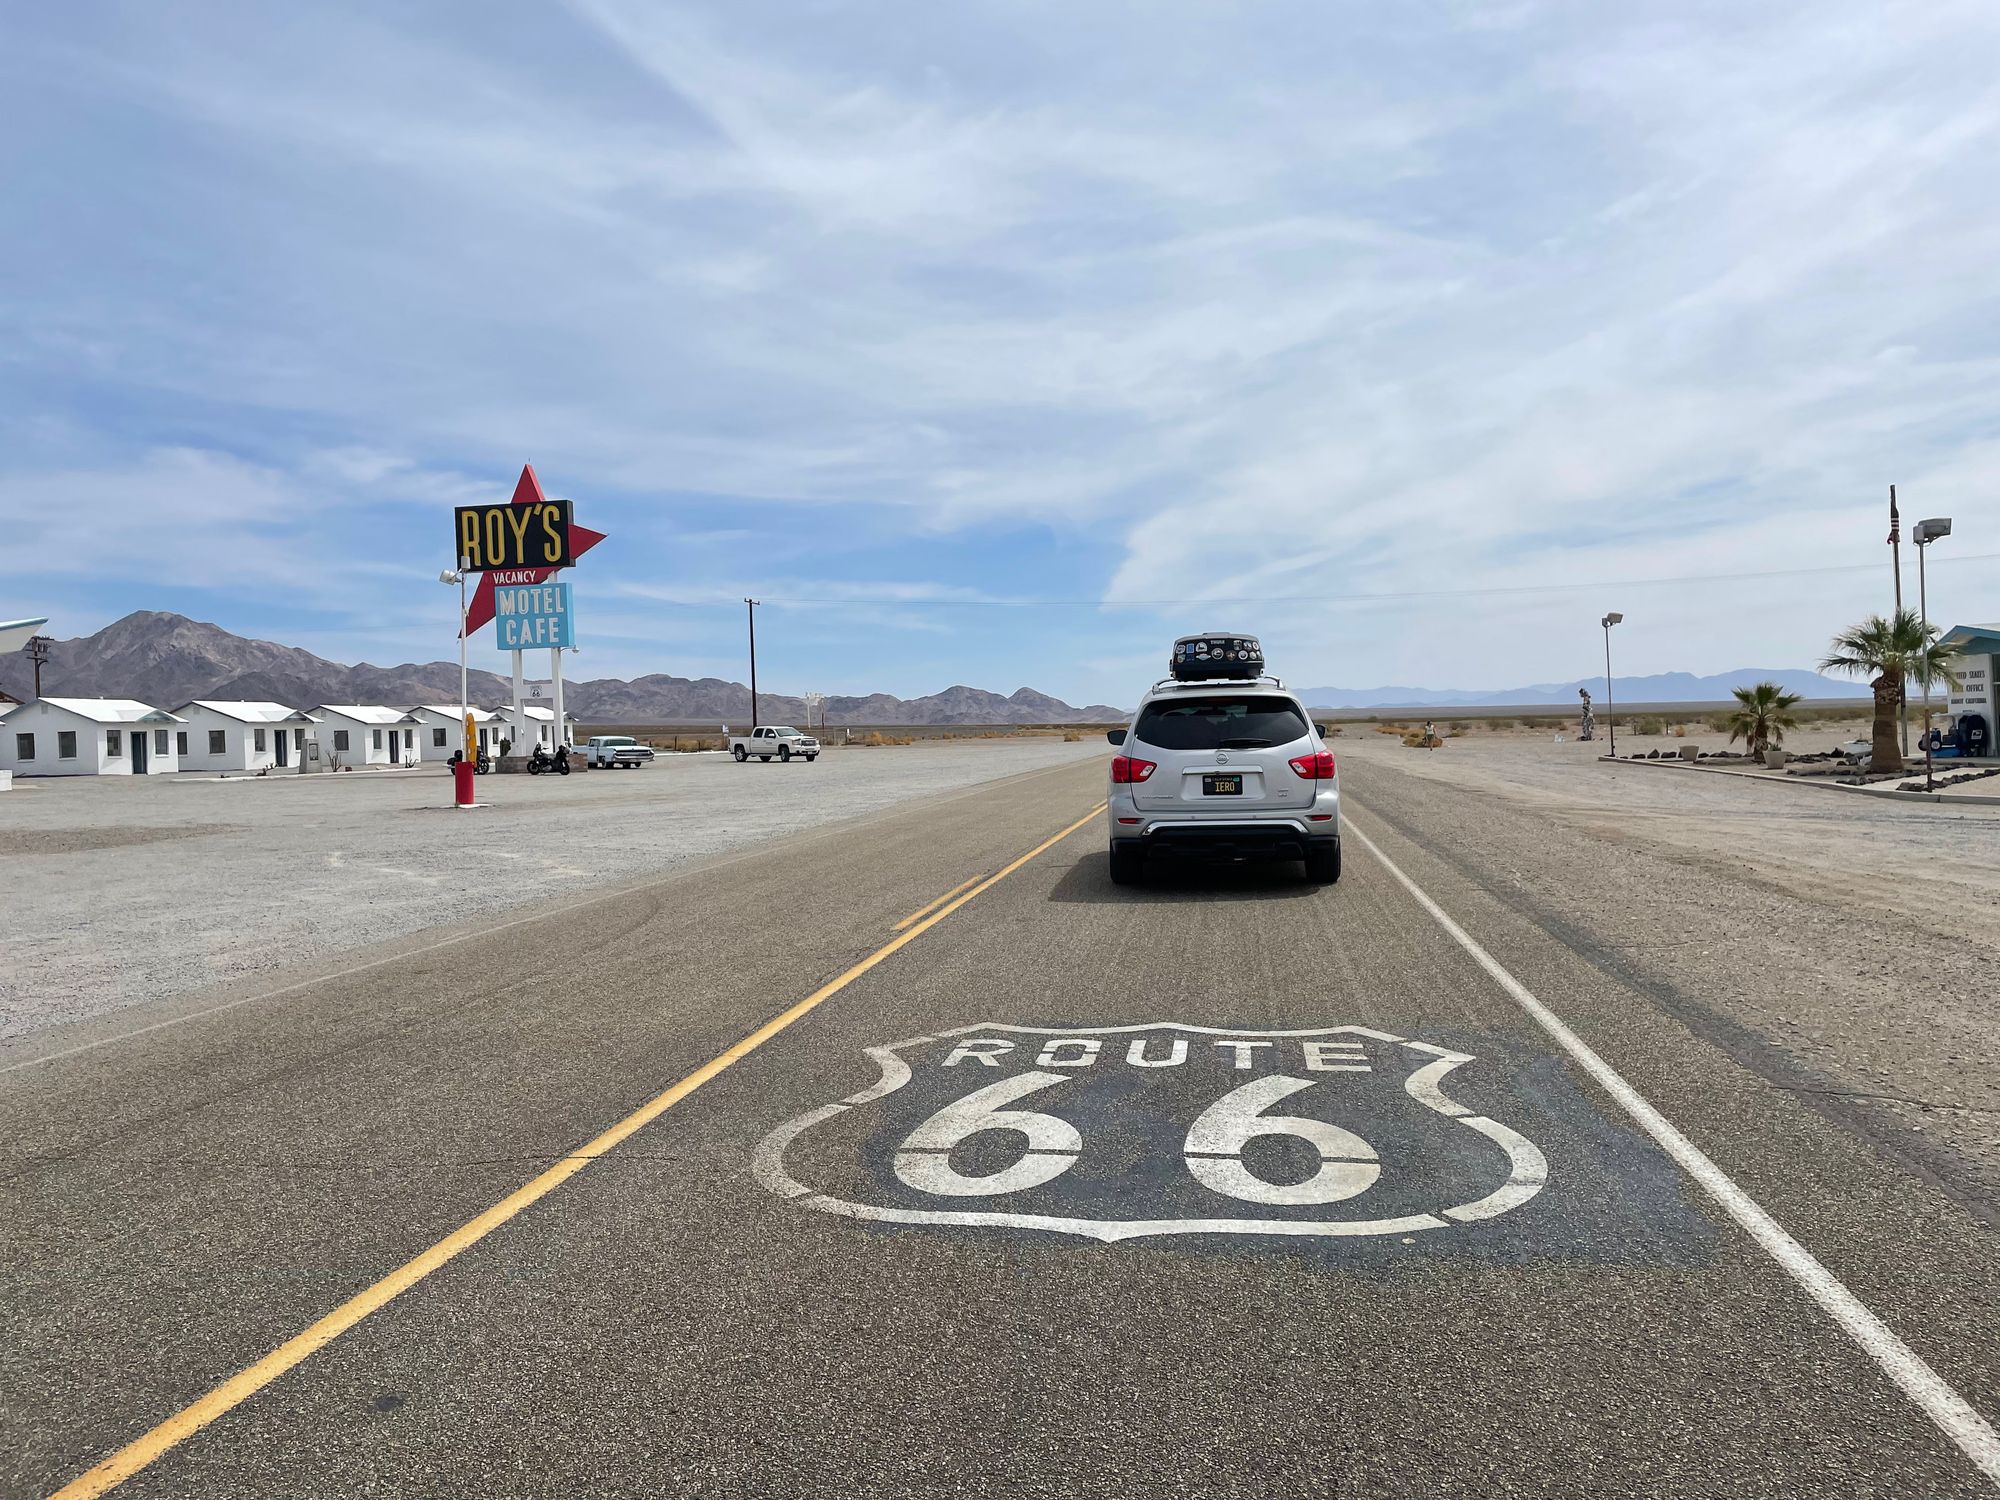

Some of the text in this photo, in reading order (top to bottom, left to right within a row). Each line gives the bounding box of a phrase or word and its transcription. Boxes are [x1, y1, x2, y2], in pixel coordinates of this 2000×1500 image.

[461, 503, 562, 566] ROY'S
[492, 570, 536, 584] VACANCY
[499, 587, 564, 616] MOTEL
[505, 617, 560, 645] CAFE
[1966, 684, 1984, 692] OFFICE
[941, 1037, 1373, 1072] ROUTE
[892, 1071, 1382, 1206] 66
